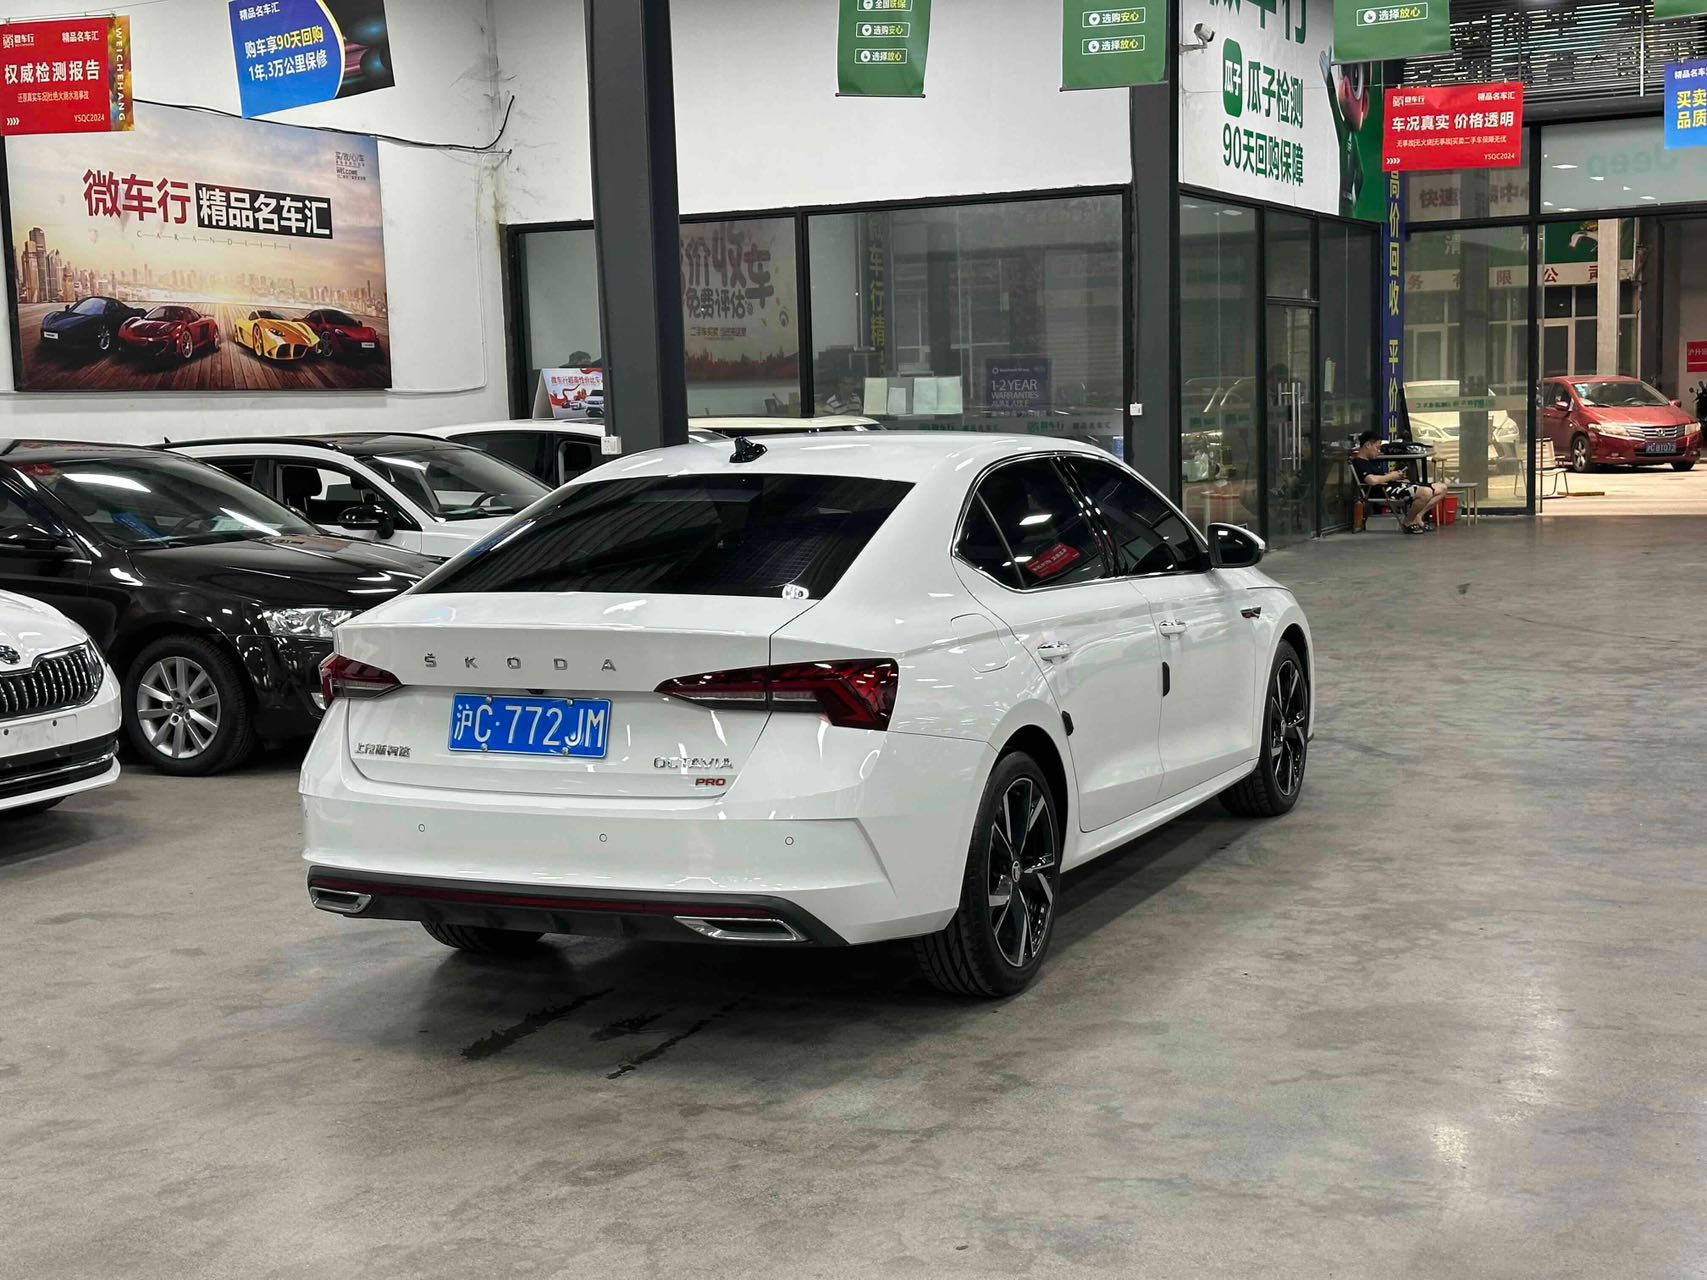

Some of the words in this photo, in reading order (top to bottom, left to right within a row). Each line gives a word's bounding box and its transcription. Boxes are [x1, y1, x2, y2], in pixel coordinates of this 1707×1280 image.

[239, 2, 280, 21] 精品名车汇
[1101, 11, 1139, 23] 选购安心
[1379, 7, 1421, 21] 选择放心
[62, 31, 99, 43] 精品名车汇
[873, 25, 903, 35] 选购安心
[244, 25, 324, 59] 购车享90天回购
[1101, 39, 1139, 51] 选择放心
[872, 51, 902, 61] 选择放心
[4, 59, 100, 84] 权威检测报告
[115, 28, 126, 121] WEICHEHANG
[1223, 60, 1242, 97] 瓜子
[1674, 67, 1707, 80] 精品名车
[1247, 60, 1304, 129] 瓜子检测
[1477, 91, 1516, 101] 精品名车汇
[1677, 88, 1707, 109] 买卖
[74, 113, 105, 123] YSQC2024
[1391, 115, 1450, 132] 车况真实
[1454, 111, 1514, 130] 价格透明
[1677, 109, 1707, 129] 品质
[1222, 123, 1304, 187] 90天回购保障
[1484, 152, 1516, 161] YSQC2024
[82, 169, 192, 226] 微车行
[198, 186, 331, 235] 精品名车汇
[1007, 379, 1038, 391] YEAR
[424, 653, 617, 672] ŠKODA
[653, 757, 733, 770] OCTAVIA
[695, 778, 727, 787] PRO
